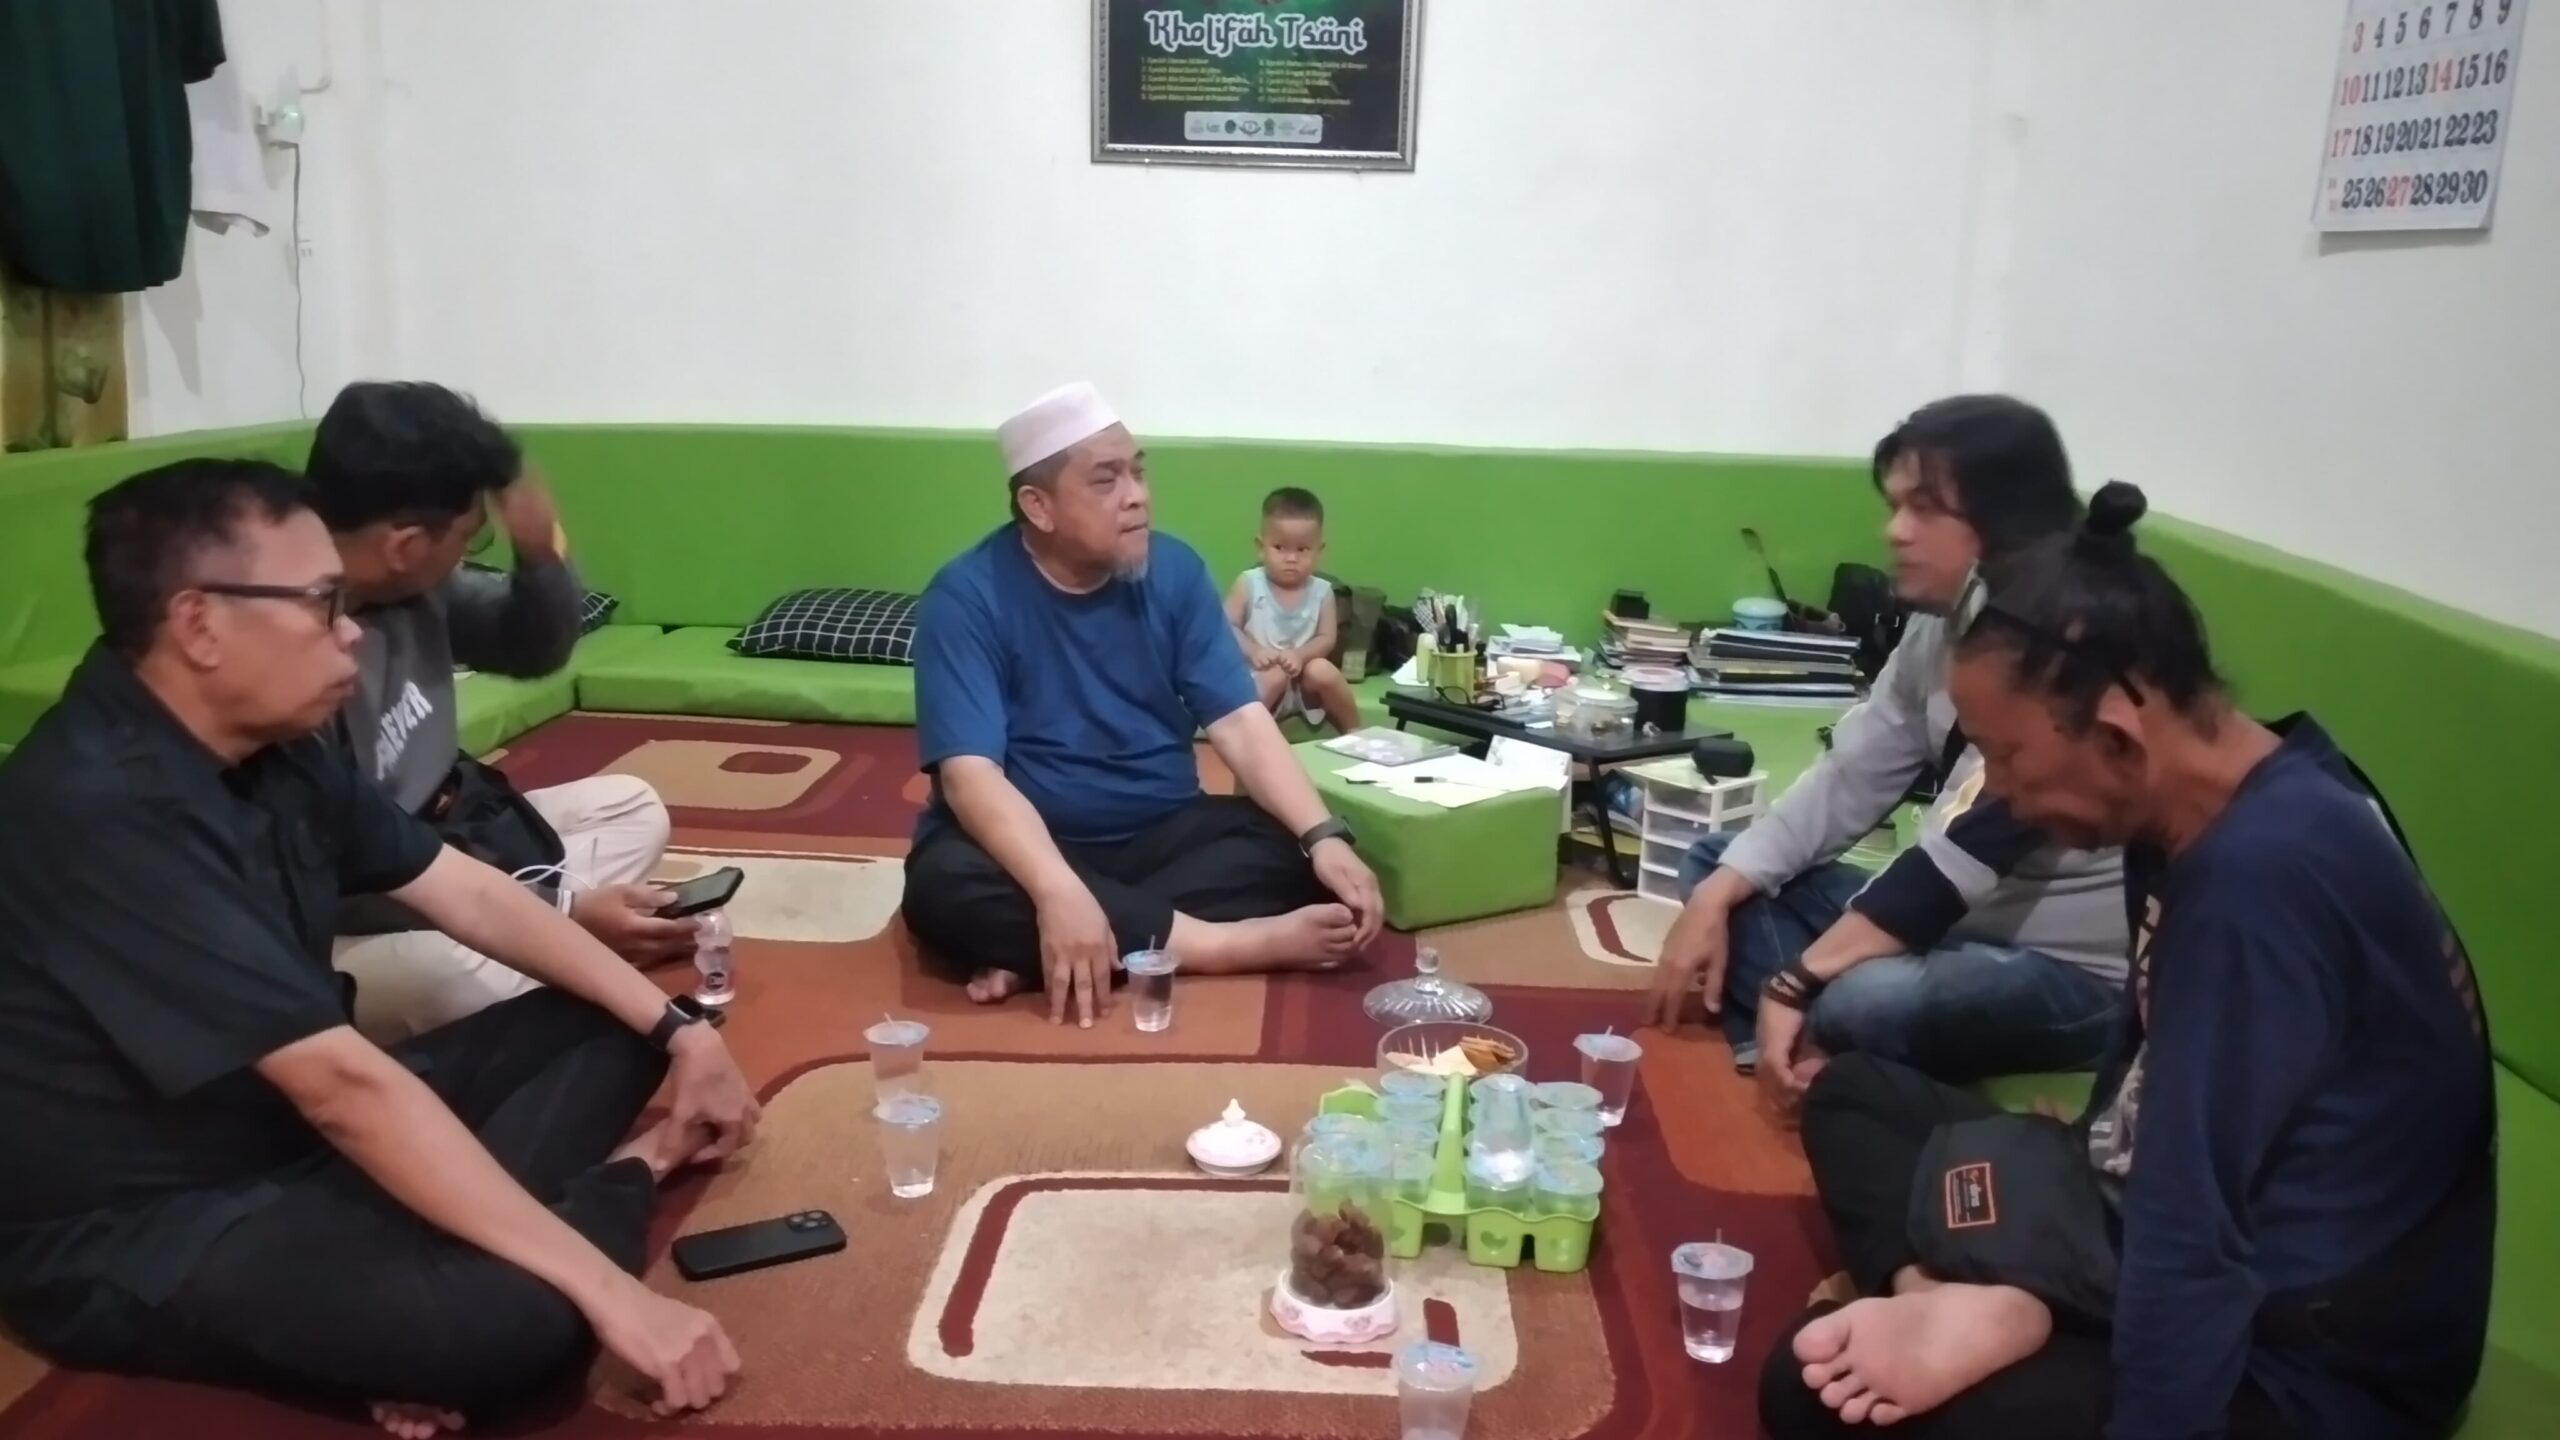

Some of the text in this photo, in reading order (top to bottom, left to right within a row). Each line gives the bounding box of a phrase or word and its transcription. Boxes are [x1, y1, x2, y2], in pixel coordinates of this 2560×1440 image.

[2353, 0, 2512, 52] 3 4 5 6 7 8 9
[2341, 48, 2508, 105] 10 11 12 13 14 15 16
[2331, 109, 2498, 157] 17 18 19 20 21 22 23
[2342, 169, 2488, 208] 25 26 27 28 29 30
